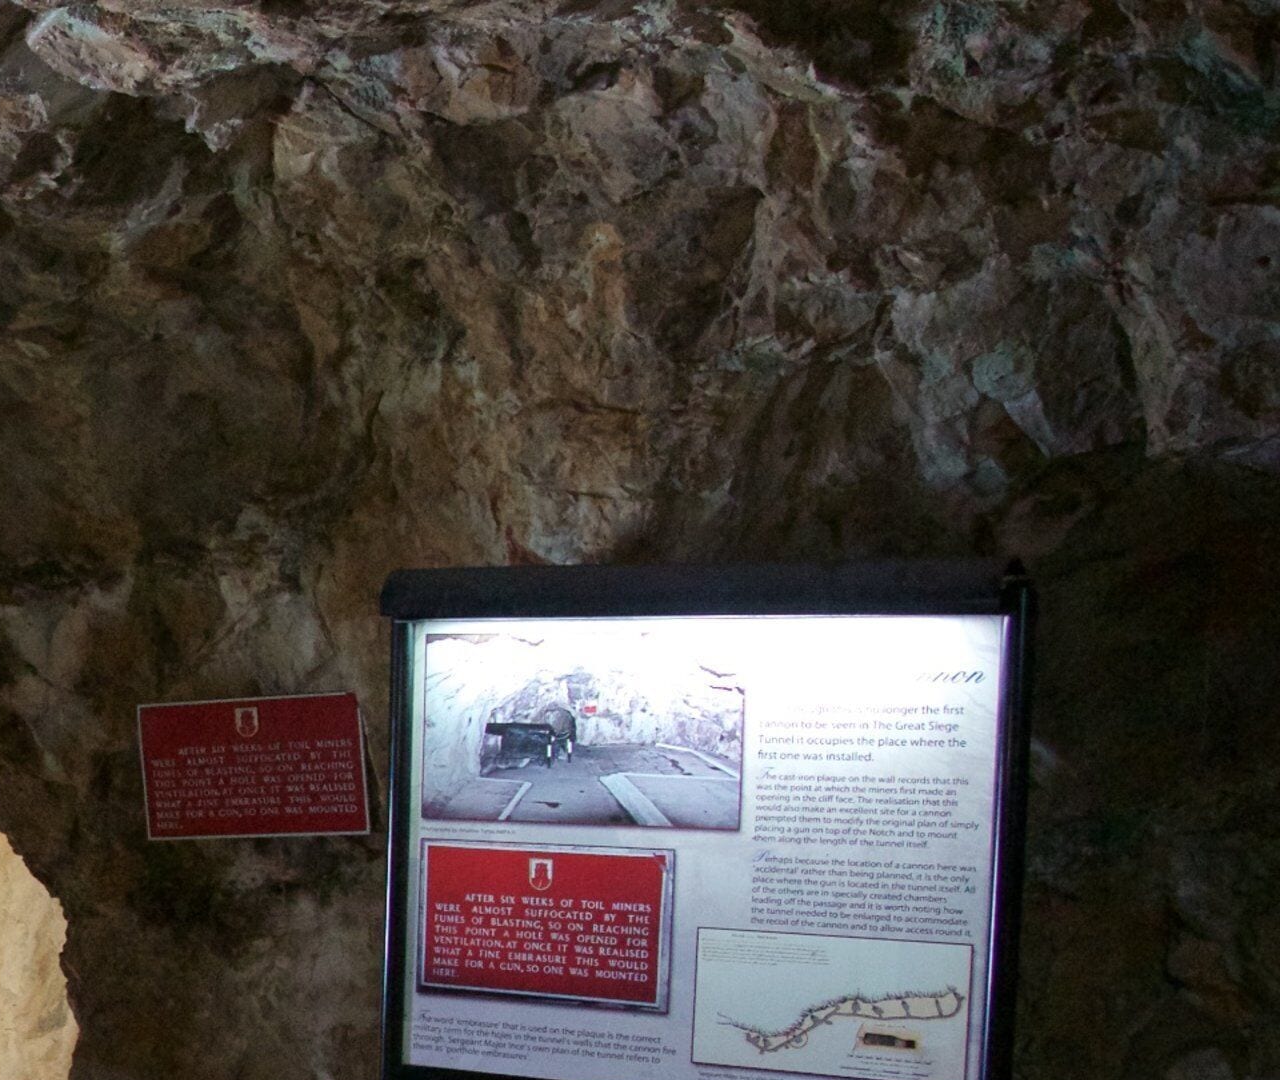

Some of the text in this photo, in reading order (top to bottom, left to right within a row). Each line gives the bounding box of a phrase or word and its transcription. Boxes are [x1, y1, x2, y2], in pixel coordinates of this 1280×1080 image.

[921, 705, 939, 713] the
[943, 705, 964, 713] first
[801, 720, 811, 729] to
[815, 720, 826, 729] be
[859, 721, 868, 729] in
[874, 721, 891, 729] The
[895, 721, 924, 730] Great
[929, 721, 960, 732] Siege
[758, 734, 967, 747] Tunnel it occupies the place where the
[758, 750, 776, 759] first
[826, 751, 875, 760] installed.
[817, 774, 845, 783] plaque
[862, 774, 875, 782] the
[878, 774, 895, 782] wall
[932, 775, 949, 783] that
[952, 775, 969, 783] this
[774, 783, 787, 791] the
[790, 784, 811, 793] point
[814, 784, 821, 792] at
[825, 784, 849, 792] which
[852, 785, 865, 793] the
[869, 785, 897, 793] miners
[899, 786, 915, 794] first
[918, 786, 941, 794] made
[755, 794, 789, 803] opening
[793, 794, 800, 802] in
[818, 795, 832, 803] cliff
[875, 796, 918, 805] realisation
[922, 797, 939, 805] that
[755, 804, 780, 812] would
[802, 805, 824, 813] make
[839, 806, 876, 814] excellent
[880, 807, 894, 815] site
[897, 807, 908, 815] for
[755, 814, 796, 824] prompted
[799, 815, 820, 823] them
[834, 816, 863, 826] modify
[866, 817, 879, 825] the
[882, 817, 913, 827] original
[917, 818, 936, 828] plan
[951, 819, 979, 829] simply
[754, 824, 784, 834] placing
[794, 827, 809, 835] gun
[825, 827, 839, 836] top
[853, 827, 865, 835] the
[869, 828, 894, 836] Notch
[916, 829, 925, 837] to
[927, 829, 957, 837] mount
[752, 835, 774, 843] them
[778, 835, 801, 845] along
[803, 836, 816, 844] the
[820, 837, 846, 847] length
[860, 838, 873, 846] the
[877, 839, 903, 847] tunnel
[465, 894, 651, 912] AFTER SIX WEEKS OF TOIL MINERS
[435, 903, 650, 924] WERE ALMOST SUFFOCATED BY THE
[434, 915, 649, 936] FUMES OF BLASTING, SO ON REACHING
[434, 925, 648, 947] THIS POINT A HOLE WAS OPENED FOR
[524, 942, 550, 952] ONCE
[558, 944, 567, 953] IT
[574, 945, 593, 955] WAS
[599, 947, 649, 958] REALISED
[433, 947, 648, 970] WHAT A FINE EMBRASURE THIS WOULD
[433, 958, 647, 982] MAKE FOR A GUN, SO ONE WAS MOUNTED
[433, 968, 459, 978] HERE.
